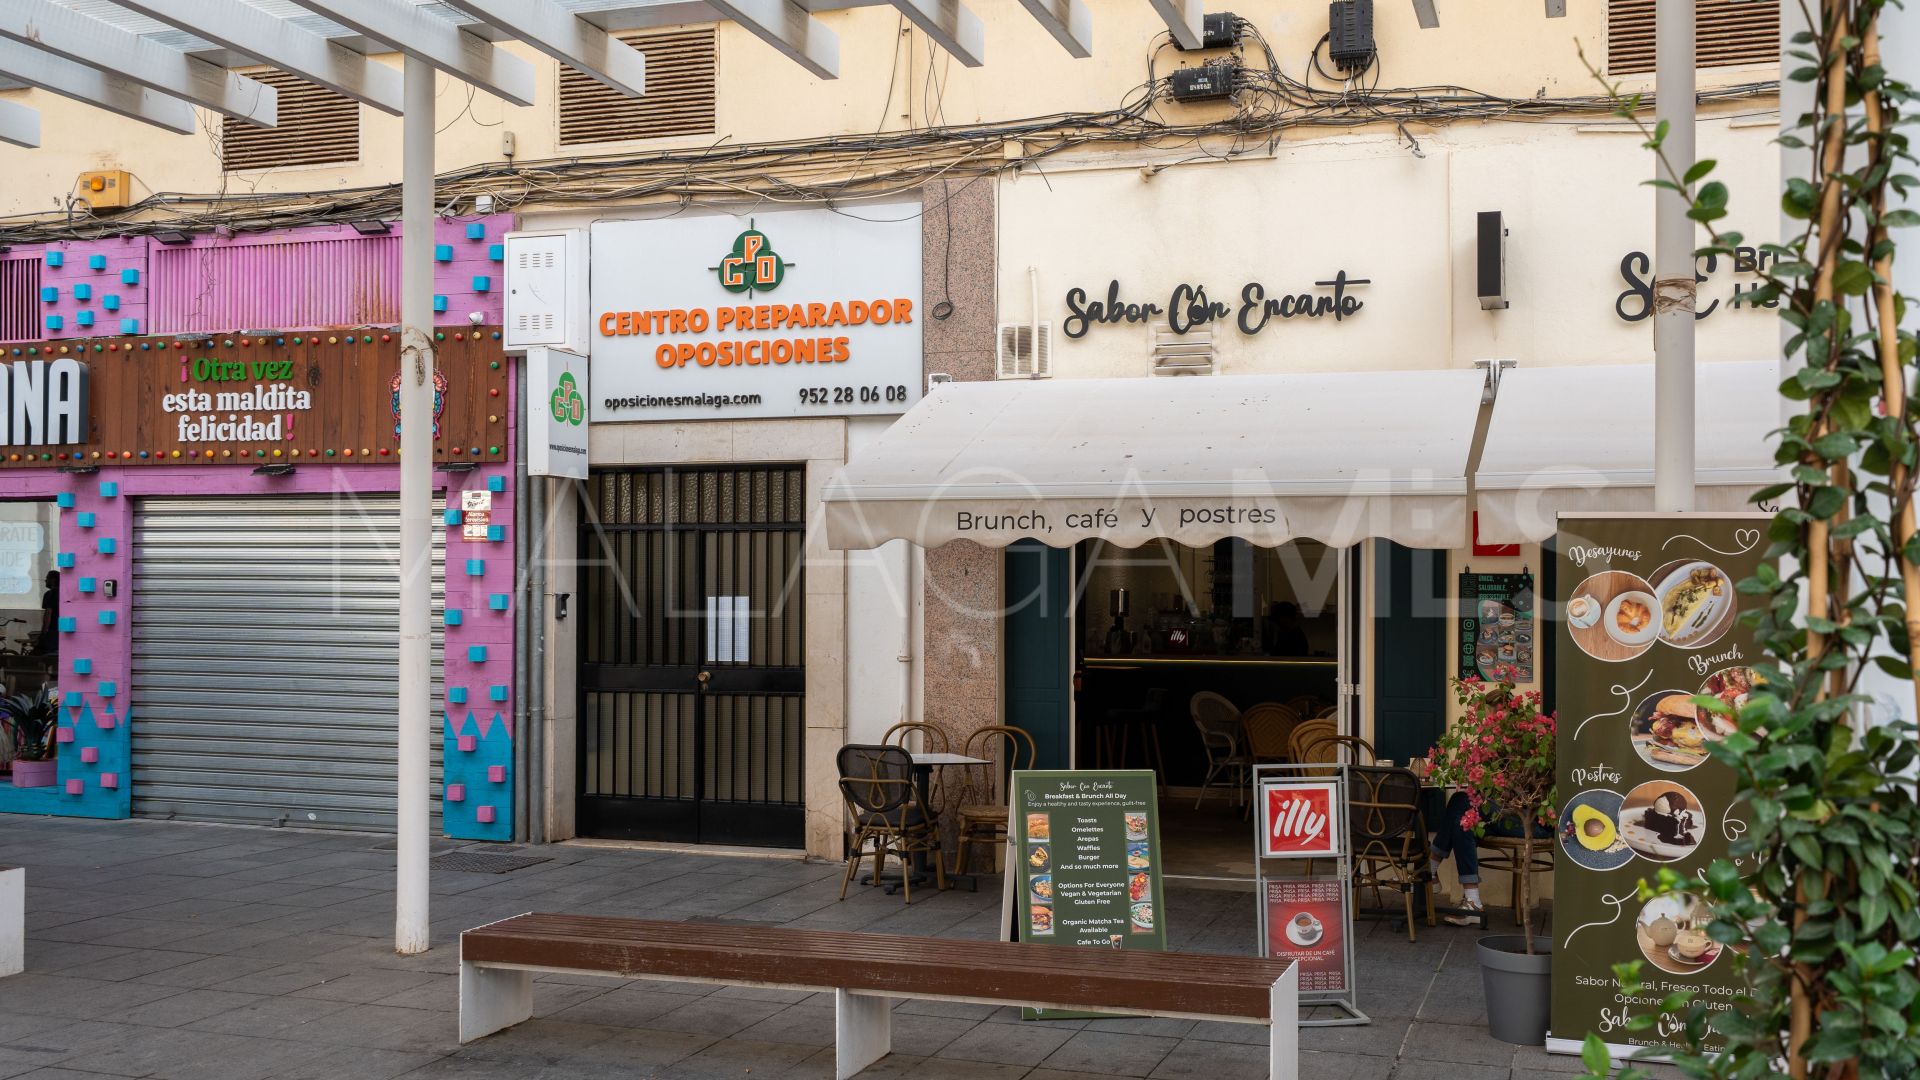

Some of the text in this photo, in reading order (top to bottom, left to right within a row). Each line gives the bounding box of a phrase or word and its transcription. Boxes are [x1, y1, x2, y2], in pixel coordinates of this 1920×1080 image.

[599, 298, 913, 336] CENTRO PREPARADOR
[1063, 279, 1163, 339] Sabor
[1237, 270, 1371, 336] Encanto
[655, 336, 850, 369] OPOSICIONES
[251, 360, 294, 381] vez
[0, 358, 82, 446] NA
[162, 382, 312, 413] esta maldita
[604, 392, 762, 411] oposicionesmalaga.com
[798, 385, 907, 404] 952 28 06 08
[177, 412, 295, 442] felicidad!
[957, 505, 1277, 534] Brunch, café y postres
[1568, 545, 1642, 567] Desayunos
[1170, 630, 1186, 643] illy
[1688, 643, 1744, 675] Brunch
[1571, 761, 1622, 786] Postres
[1273, 799, 1326, 846] illy
[1062, 918, 1088, 926] Organic
[1575, 975, 1609, 987] Sabor
[1661, 981, 1700, 993] Fresco
[1703, 984, 1733, 996] Todo
[1735, 987, 1746, 996] el
[1614, 993, 1664, 1006] Opcione
[1628, 1037, 1659, 1047] Brunch
